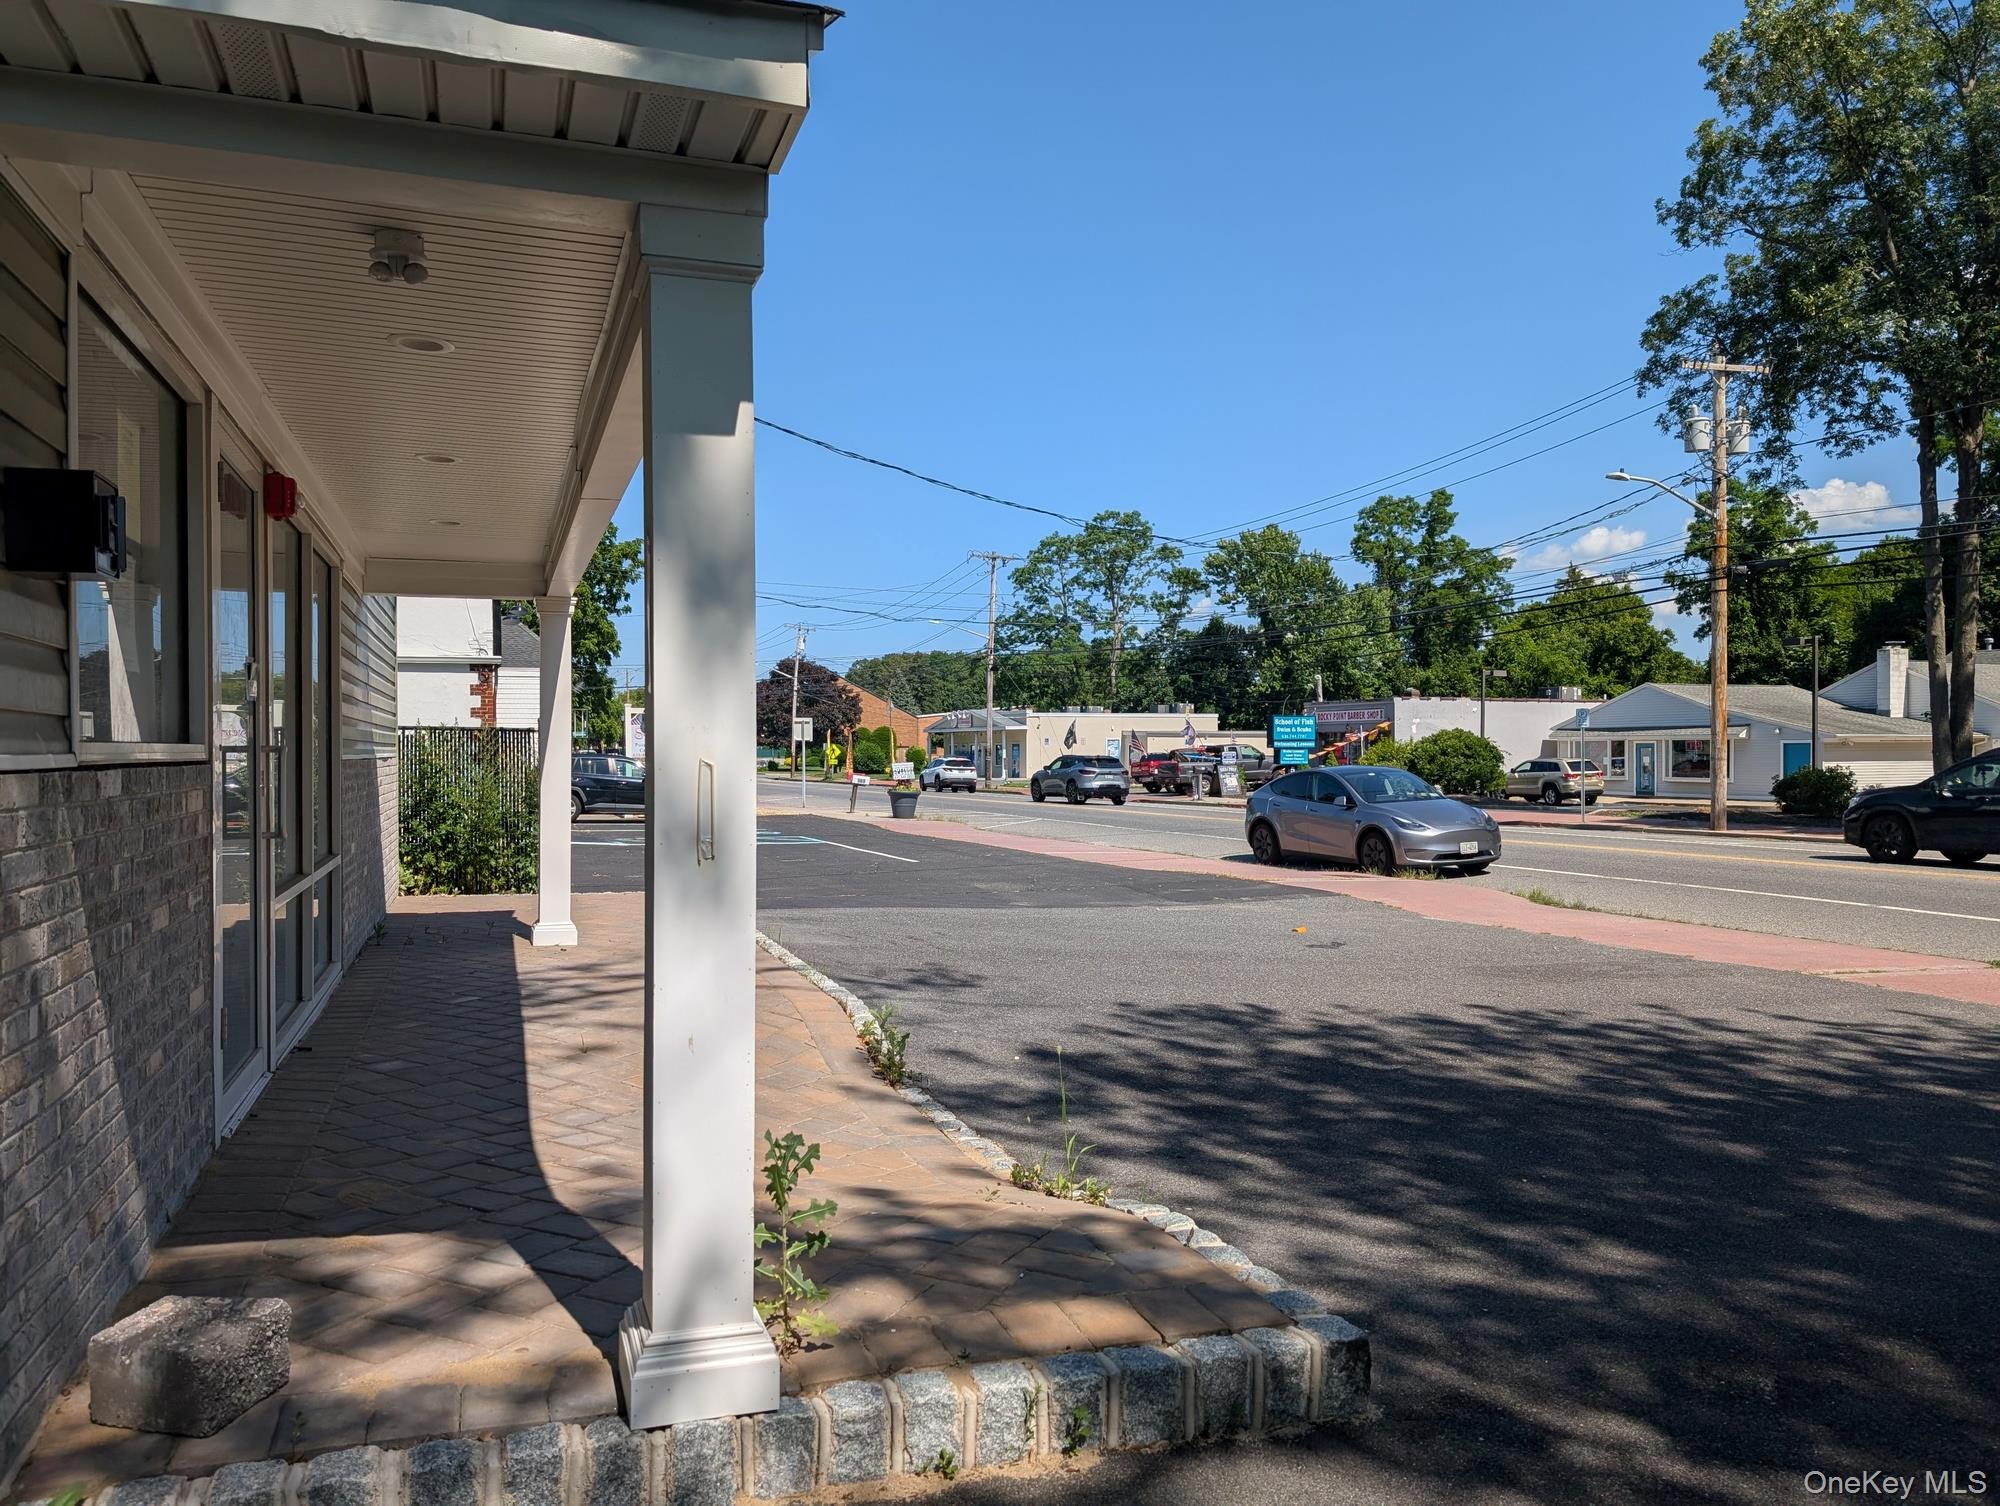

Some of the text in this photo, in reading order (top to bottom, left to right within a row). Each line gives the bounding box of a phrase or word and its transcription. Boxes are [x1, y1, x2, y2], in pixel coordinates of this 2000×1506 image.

[1317, 712, 1333, 720] ROCKY
[1333, 711, 1347, 720] POINT
[1347, 711, 1366, 720] BARBER
[1366, 710, 1379, 719] SHOP
